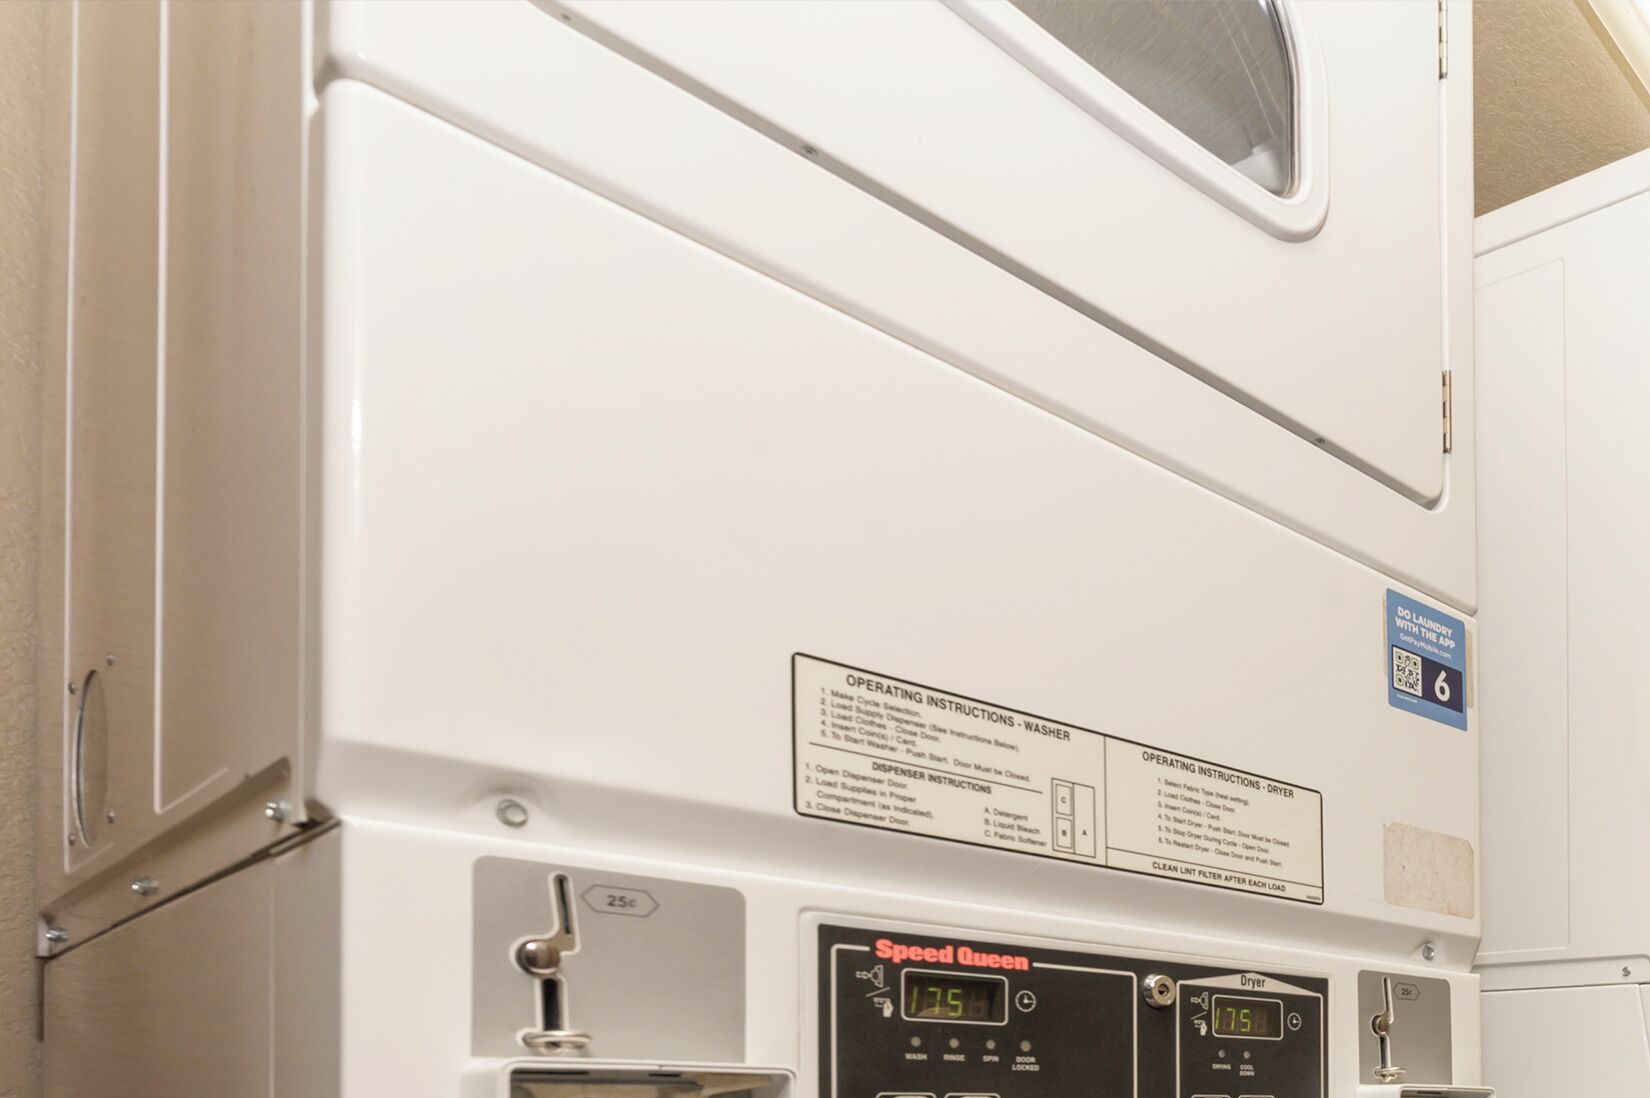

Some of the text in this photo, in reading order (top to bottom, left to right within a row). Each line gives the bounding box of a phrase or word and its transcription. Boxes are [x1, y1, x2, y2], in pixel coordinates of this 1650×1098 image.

[1395, 617, 1456, 649] WITH THE APP
[1398, 607, 1452, 638] DO LAUNDRY
[1434, 670, 1450, 702] 6
[846, 674, 1070, 742] OPERATING INSTRUCTIONS WASHER
[872, 761, 992, 794] DISPENSER INSTRUCTIONS
[1142, 751, 1294, 798] OPERATING INSTRUCTIONS DRYER
[1152, 862, 1286, 893] CLEAN LINT FILTER AFTER EACH LOAD
[876, 938, 1029, 971] Speed Queen
[1240, 974, 1266, 988] Dryer
[910, 986, 964, 1017] 175
[1215, 1008, 1250, 1032] 175
[944, 1054, 966, 1062] RINSE
